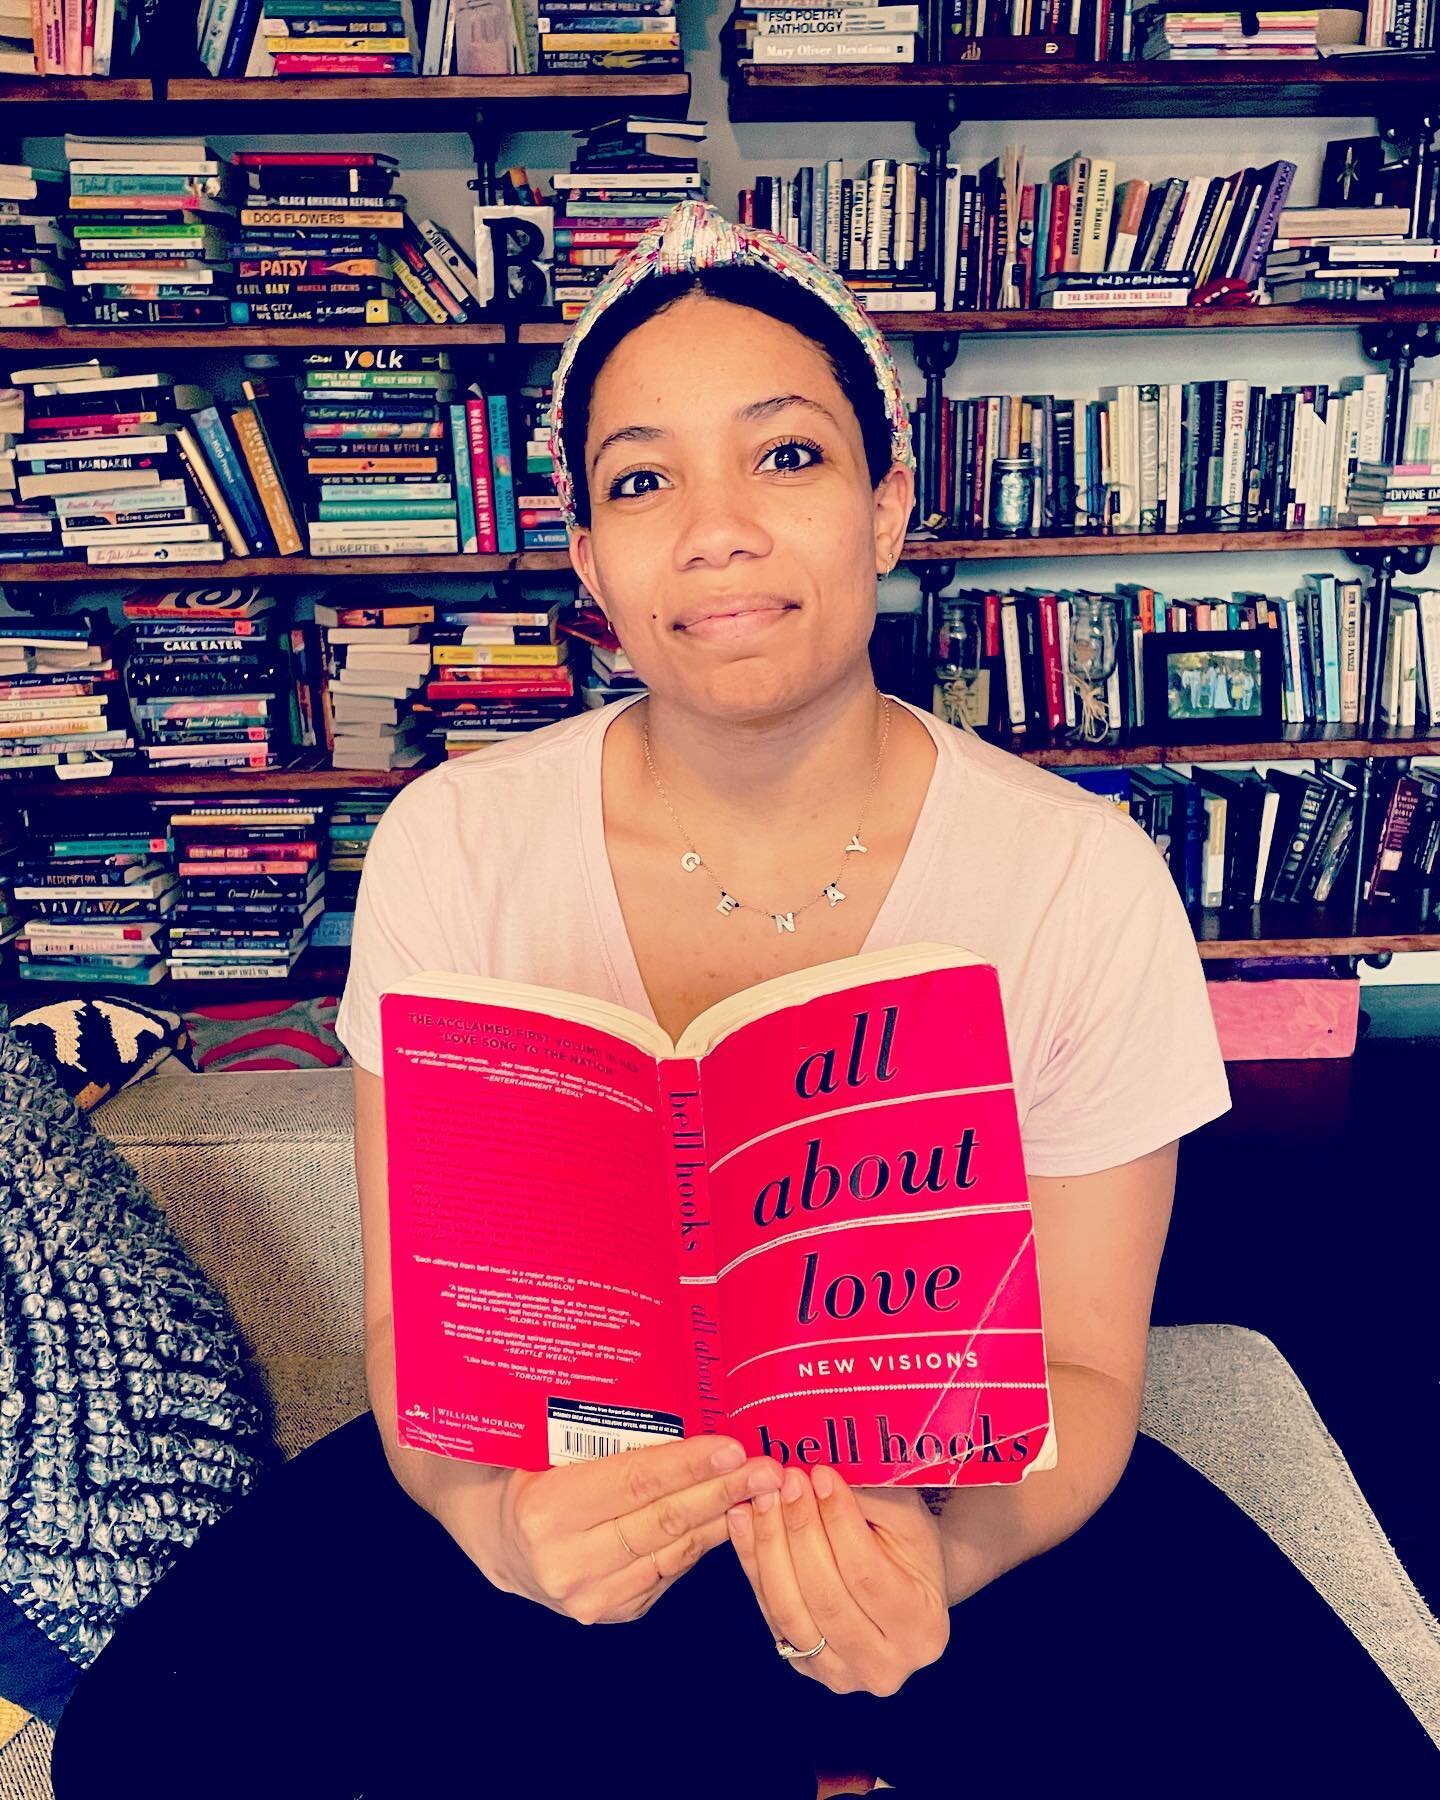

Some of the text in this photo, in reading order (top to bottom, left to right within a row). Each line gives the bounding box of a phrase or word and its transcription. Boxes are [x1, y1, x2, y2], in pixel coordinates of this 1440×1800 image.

[769, 9, 843, 22] FSG POETRY
[769, 22, 843, 34] ANTHOLOGY
[766, 45, 794, 58] Mary
[798, 45, 830, 55] Oliver
[253, 212, 345, 224] DOG FLOWERS
[260, 260, 307, 277] PATSY
[257, 312, 271, 320] WE
[344, 349, 404, 369] YOLK
[1230, 400, 1244, 429] RACE
[1391, 489, 1425, 501] DIVINE
[328, 543, 380, 554] LIBERTIE
[163, 640, 243, 651] CAKE EATER
[408, 1012, 433, 1026] THE
[436, 1018, 512, 1036] ACCLAIMED
[482, 1037, 568, 1061] SONG TO THE
[796, 1006, 899, 1101] all
[554, 1086, 584, 1099] WEEKLY
[670, 1091, 708, 1253] bell hooks
[753, 1127, 981, 1228] about
[432, 1258, 459, 1269] offering
[459, 1262, 476, 1270] from
[477, 1264, 490, 1272] bell
[490, 1266, 511, 1275] hooks
[536, 1280, 575, 1292] ANGELOU
[798, 1253, 962, 1326] love
[551, 1298, 565, 1306] look
[588, 1303, 606, 1312] most
[563, 1307, 583, 1317] being
[508, 1308, 521, 1316] bell
[522, 1310, 543, 1319] hooks
[574, 1317, 592, 1325] more
[542, 1320, 577, 1332] STEINEM
[493, 1337, 505, 1345] the
[534, 1343, 547, 1351] and
[562, 1347, 574, 1355] the
[603, 1353, 615, 1361] the
[544, 1351, 578, 1363] WEEKLY
[692, 1304, 723, 1402] all about
[497, 1361, 510, 1369] this
[511, 1363, 529, 1372] book
[536, 1368, 557, 1377] worth
[557, 1369, 570, 1378] the
[800, 1352, 979, 1378] NEW VISIONS
[555, 1377, 571, 1386] SUN
[437, 1407, 526, 1431] WILLIAM MORROW
[758, 1416, 1030, 1466] bell hooks
